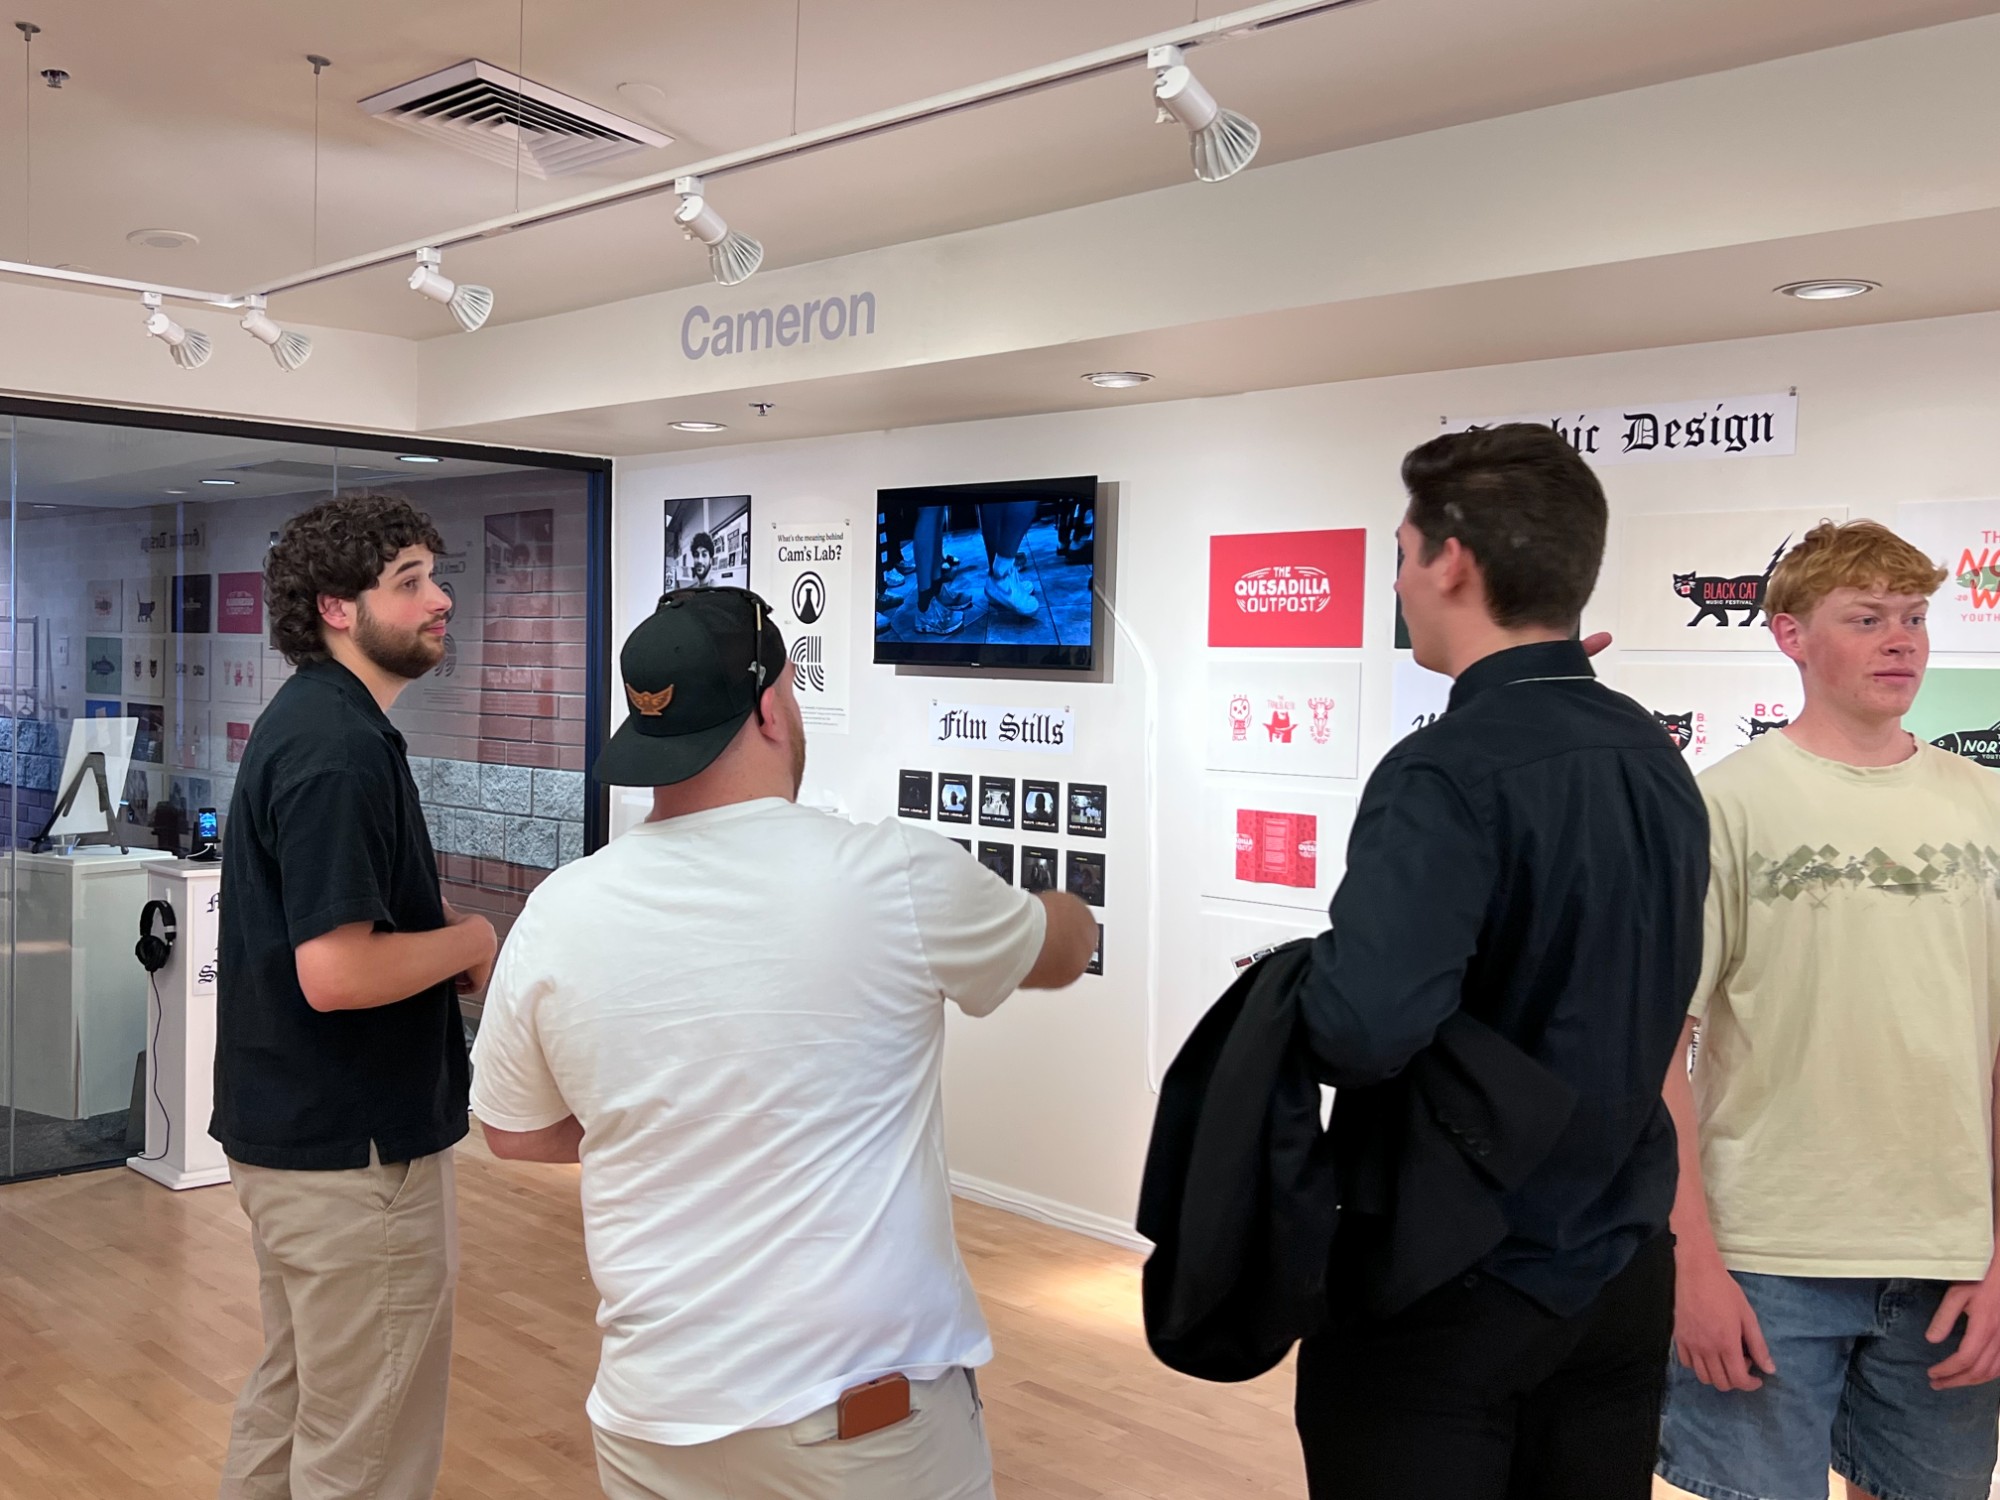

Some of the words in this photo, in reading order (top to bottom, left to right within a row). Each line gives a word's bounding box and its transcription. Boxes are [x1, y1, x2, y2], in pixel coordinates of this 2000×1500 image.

[681, 291, 876, 360] Cameron
[1620, 403, 1775, 453] Design
[777, 534, 794, 542] What's
[795, 534, 804, 542] the
[804, 533, 825, 543] meaning
[826, 532, 844, 541] behind
[778, 545, 812, 562] Cam's
[814, 544, 842, 561] Lab?
[1273, 566, 1291, 578] THE
[1234, 577, 1331, 596] QUESADILLA
[1703, 582, 1737, 599] BLACK
[1739, 582, 1758, 599] CAT
[1247, 596, 1317, 613] OUTPOST
[937, 709, 987, 741] Film
[998, 712, 1065, 745] Stills
